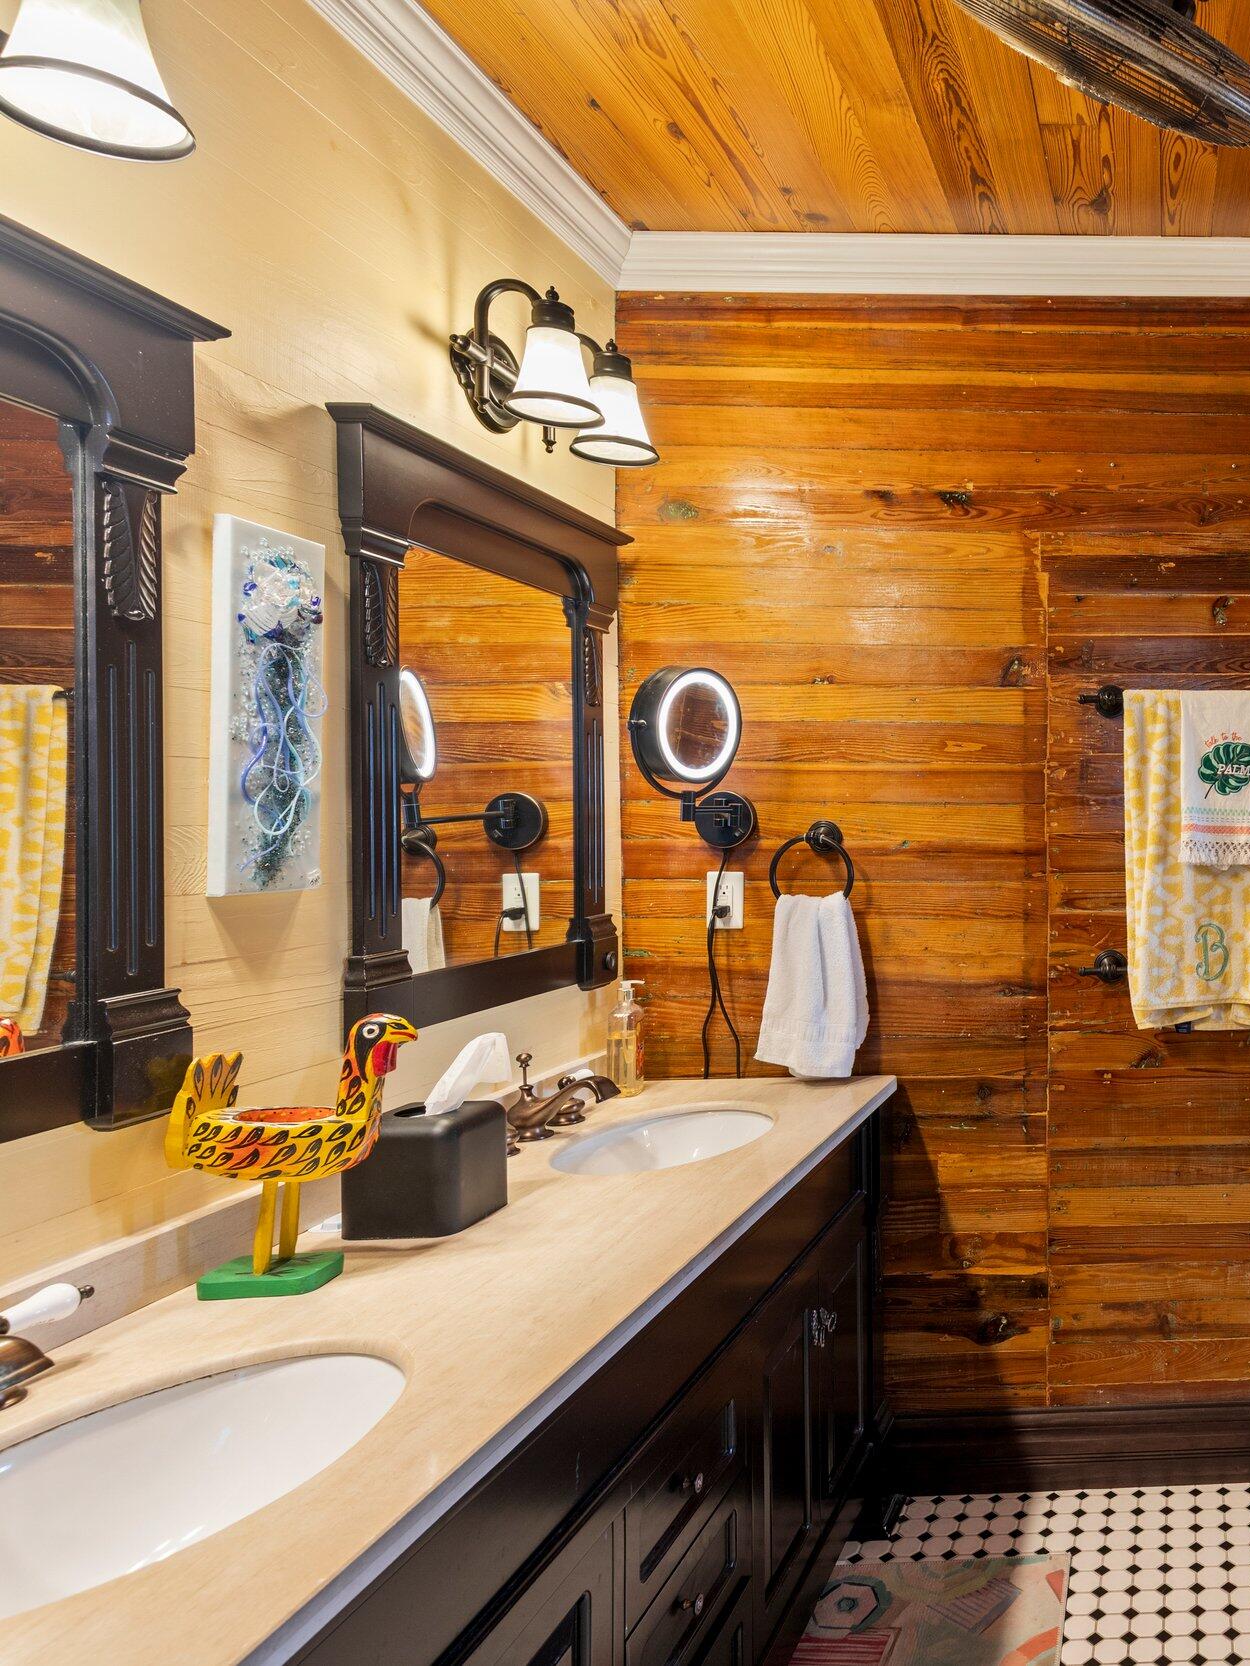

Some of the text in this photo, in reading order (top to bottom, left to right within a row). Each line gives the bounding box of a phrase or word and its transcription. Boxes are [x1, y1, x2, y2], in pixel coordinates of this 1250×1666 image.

[1205, 731, 1243, 748] talk to the
[1194, 923, 1229, 981] B
